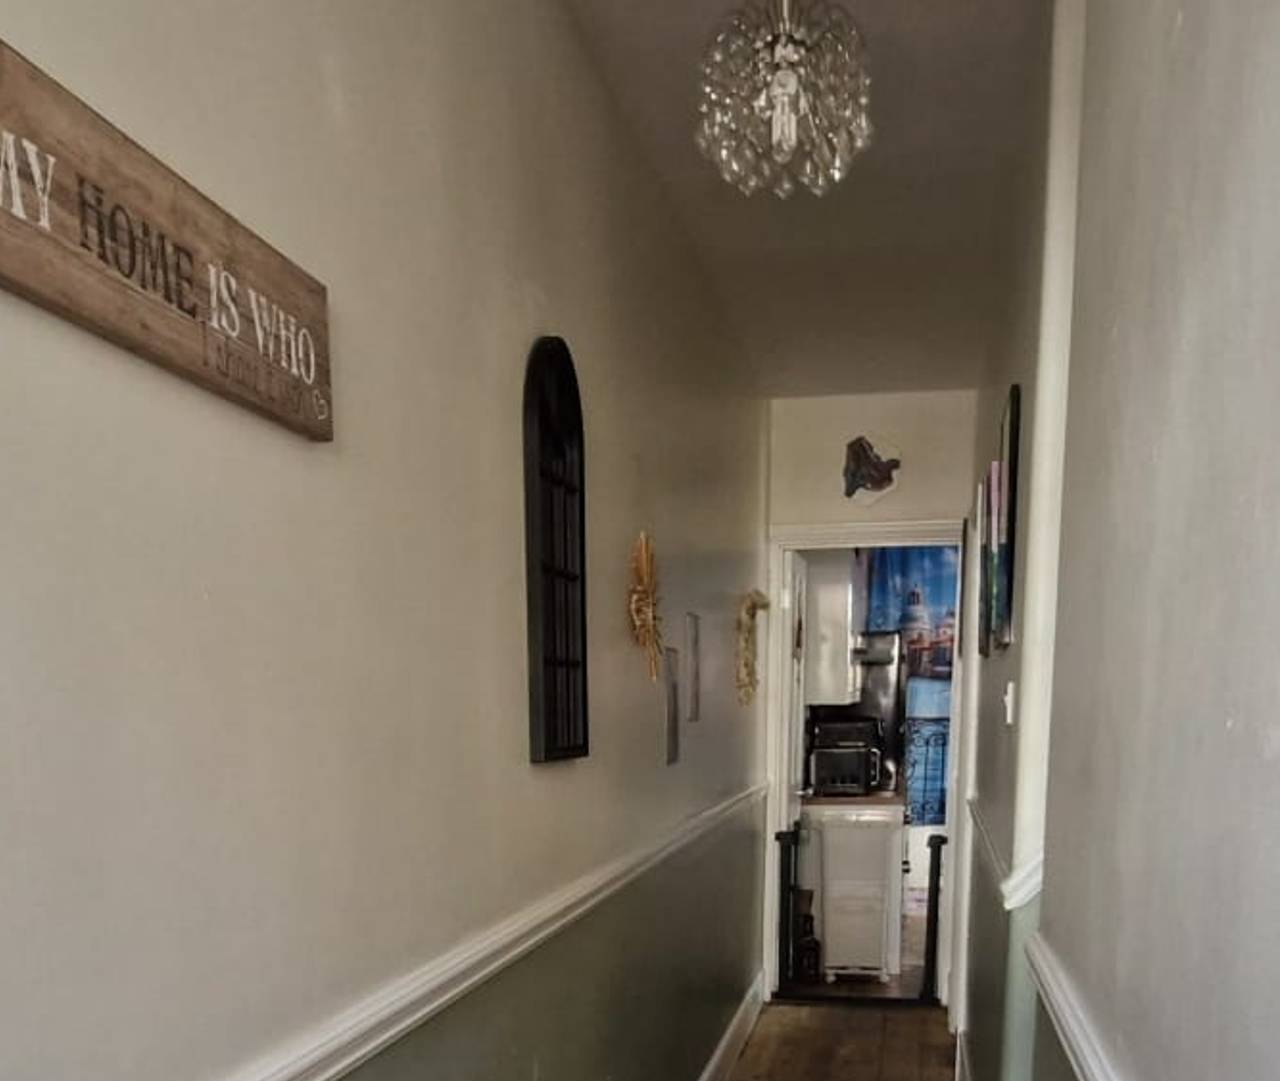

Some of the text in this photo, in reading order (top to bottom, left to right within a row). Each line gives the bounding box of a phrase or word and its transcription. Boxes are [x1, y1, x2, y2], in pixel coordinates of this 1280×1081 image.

[75, 172, 198, 318] HOME
[208, 263, 240, 338] IS
[248, 288, 316, 385] WHO
